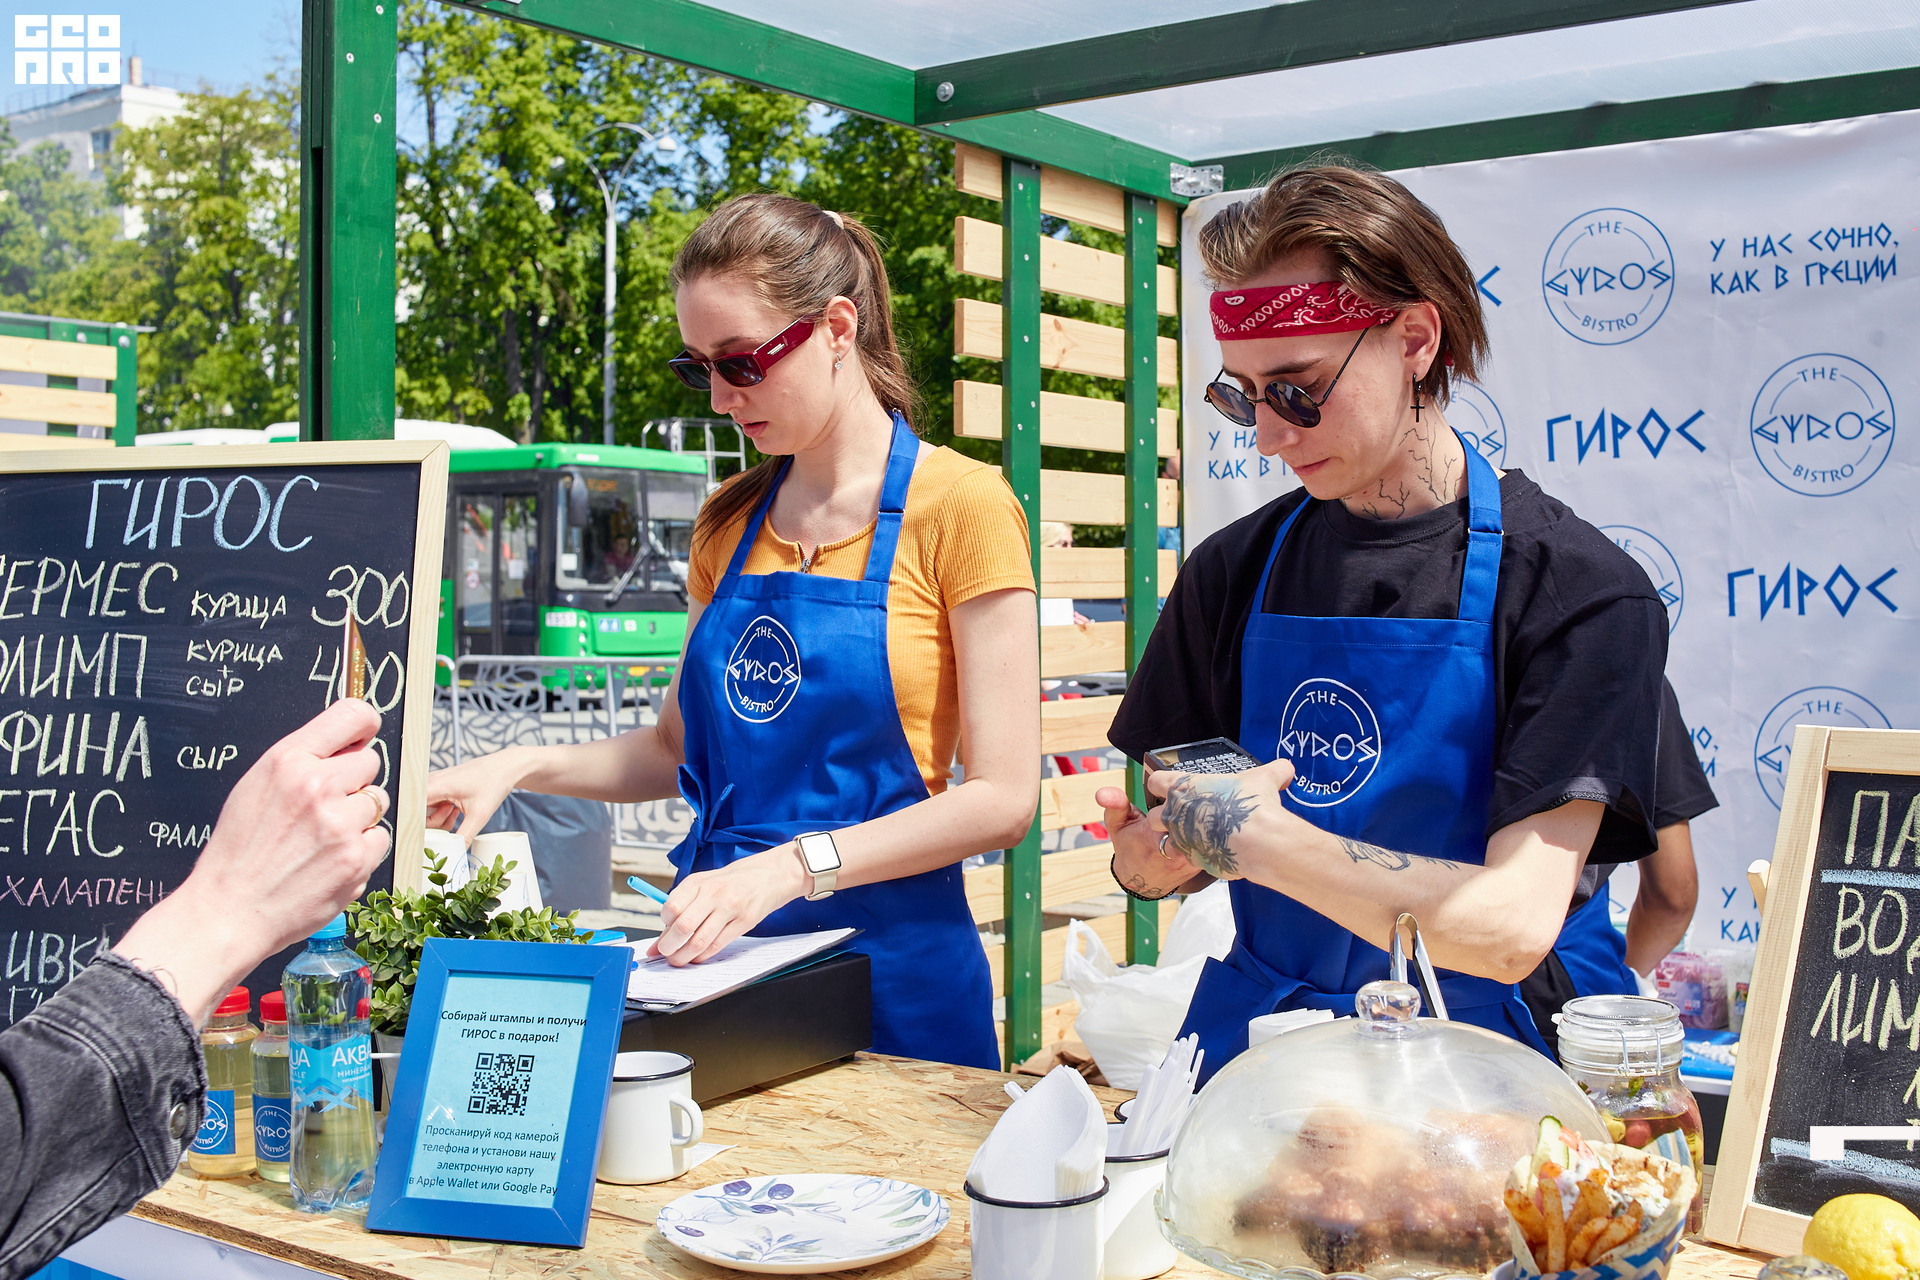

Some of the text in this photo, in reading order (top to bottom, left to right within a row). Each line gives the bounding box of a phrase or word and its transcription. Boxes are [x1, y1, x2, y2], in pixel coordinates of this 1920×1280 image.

[1584, 221, 1622, 237] THE
[1710, 222, 1899, 262] У НАС СОЧНО,
[1544, 260, 1672, 297] GYROS
[1710, 253, 1897, 295] КАК В ГРЕЦИИ
[1581, 312, 1638, 332] BISTRO
[1797, 367, 1838, 382] THE
[1546, 406, 1707, 466] ГИРОС
[1753, 409, 1892, 445] GYROS
[1208, 430, 1221, 451] У
[1208, 458, 1248, 480] КАК
[1259, 456, 1270, 477] В
[1792, 463, 1855, 483] BISTRO
[85, 475, 320, 552] ГИРОС
[0, 554, 410, 630] ЕРМЕС КУРИЦА 300
[1727, 561, 1898, 622] ГИРОС
[755, 625, 772, 639] THE
[186, 638, 284, 671] КУРИЦА
[185, 675, 245, 699] СЫР
[740, 695, 775, 714] BISTRO
[1306, 690, 1338, 706] THE
[1803, 700, 1842, 716] THE
[0, 710, 152, 782] ФИНА
[177, 744, 238, 770] СЫР
[1296, 775, 1341, 796] BISTRO
[441, 1010, 587, 1028] Собирай штампы и получи
[461, 1028, 560, 1044] ГИРОС в подарок!
[264, 1110, 277, 1118] THE
[425, 1125, 560, 1144] Просканируй код камерой
[264, 1143, 286, 1154] BISTRO
[422, 1142, 557, 1162] телефона и установи нашу
[437, 1161, 534, 1178] электронную карту
[416, 1175, 444, 1188] Apple
[447, 1177, 478, 1190] Wallet
[481, 1182, 500, 1190] или
[502, 1181, 538, 1195] Google
[540, 1184, 558, 1197] Pay
